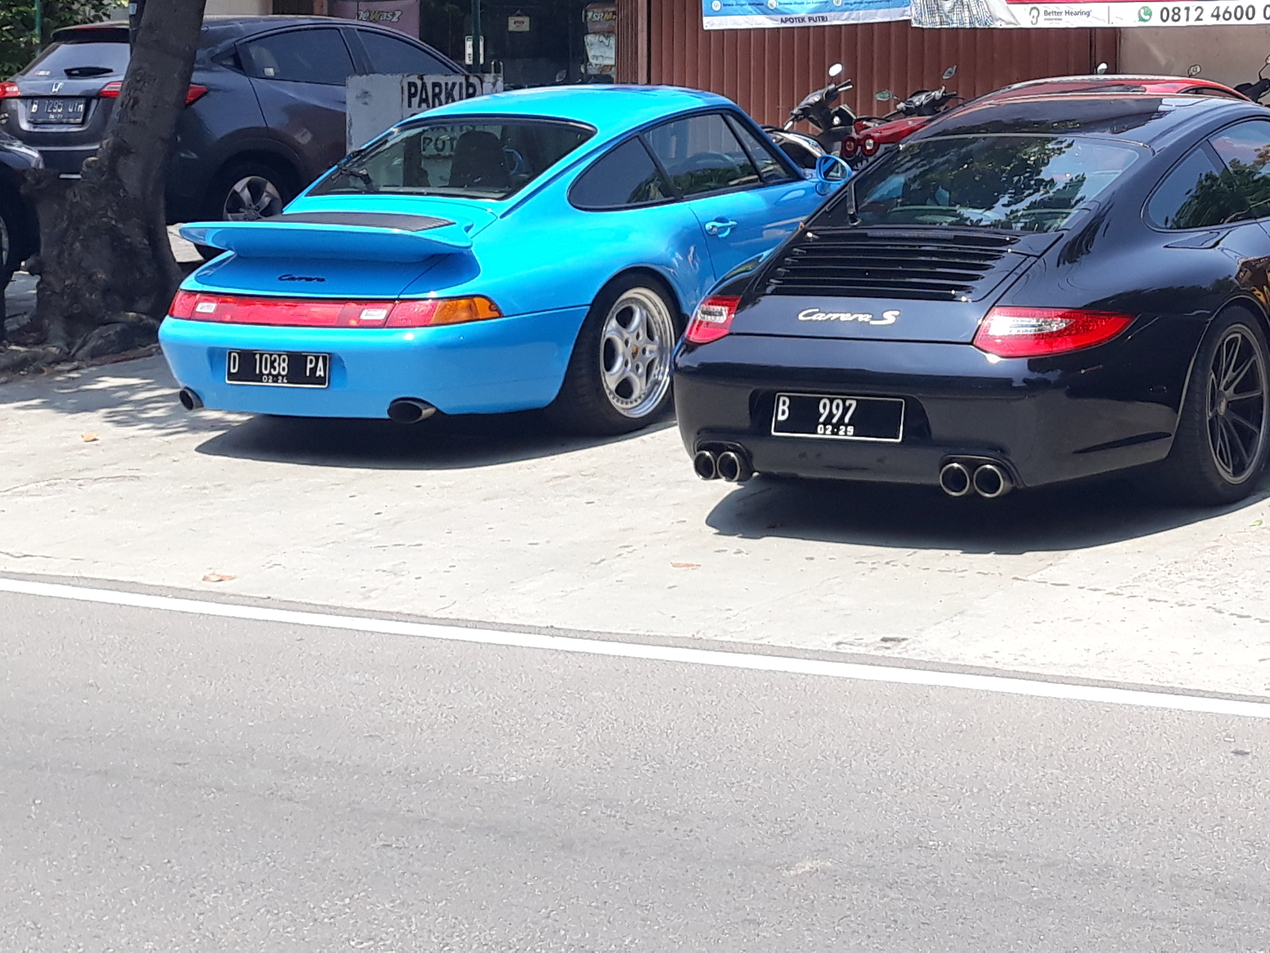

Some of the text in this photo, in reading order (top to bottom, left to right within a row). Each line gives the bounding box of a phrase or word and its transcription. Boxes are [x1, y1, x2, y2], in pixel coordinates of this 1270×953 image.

[1043, 9, 1063, 17] Better
[1160, 5, 1204, 23] 0812
[1210, 4, 1256, 22] 4600
[798, 308, 900, 325] Carrera S
[229, 352, 325, 378] D 1038 PA
[777, 396, 857, 424] B 997
